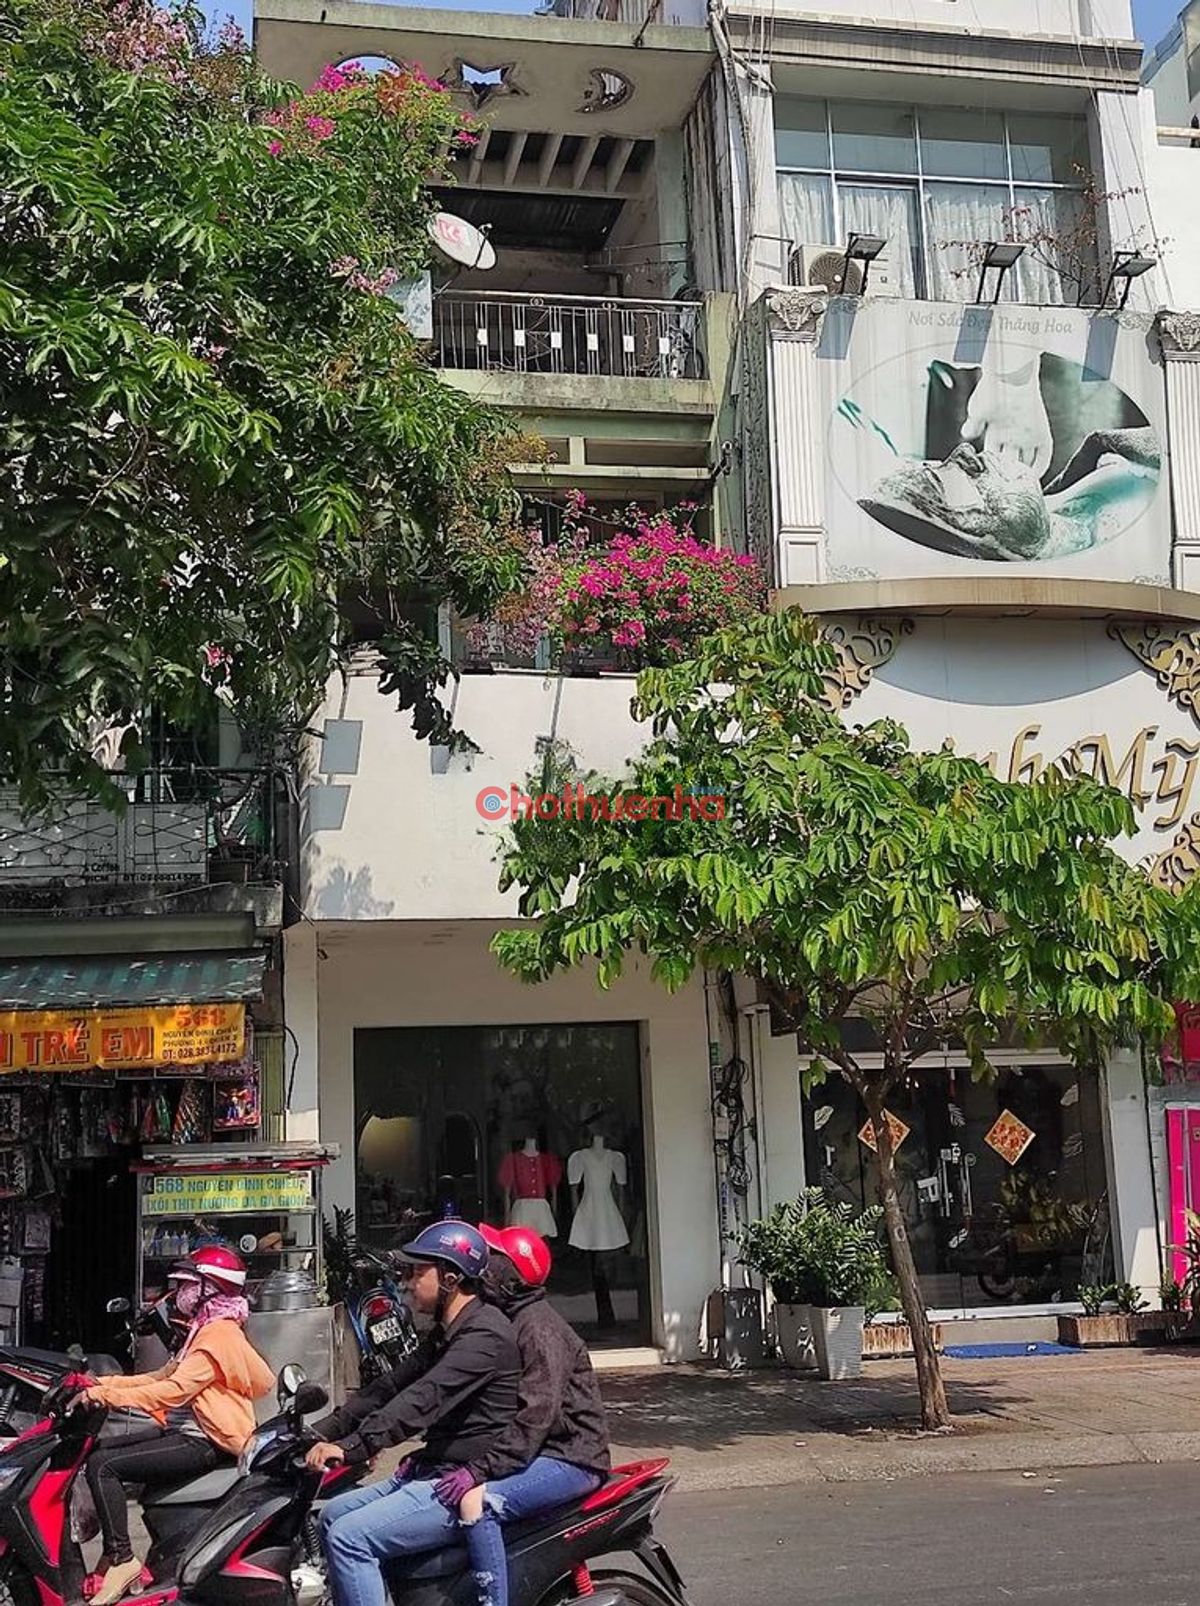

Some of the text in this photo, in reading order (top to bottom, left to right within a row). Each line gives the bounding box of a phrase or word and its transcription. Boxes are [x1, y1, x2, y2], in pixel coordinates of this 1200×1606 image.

[908, 311, 932, 326] Nơi
[1044, 317, 1073, 334] Hoa
[20, 1017, 90, 1065] TRẺ
[101, 1026, 154, 1062] EM
[155, 1177, 185, 1193] 568
